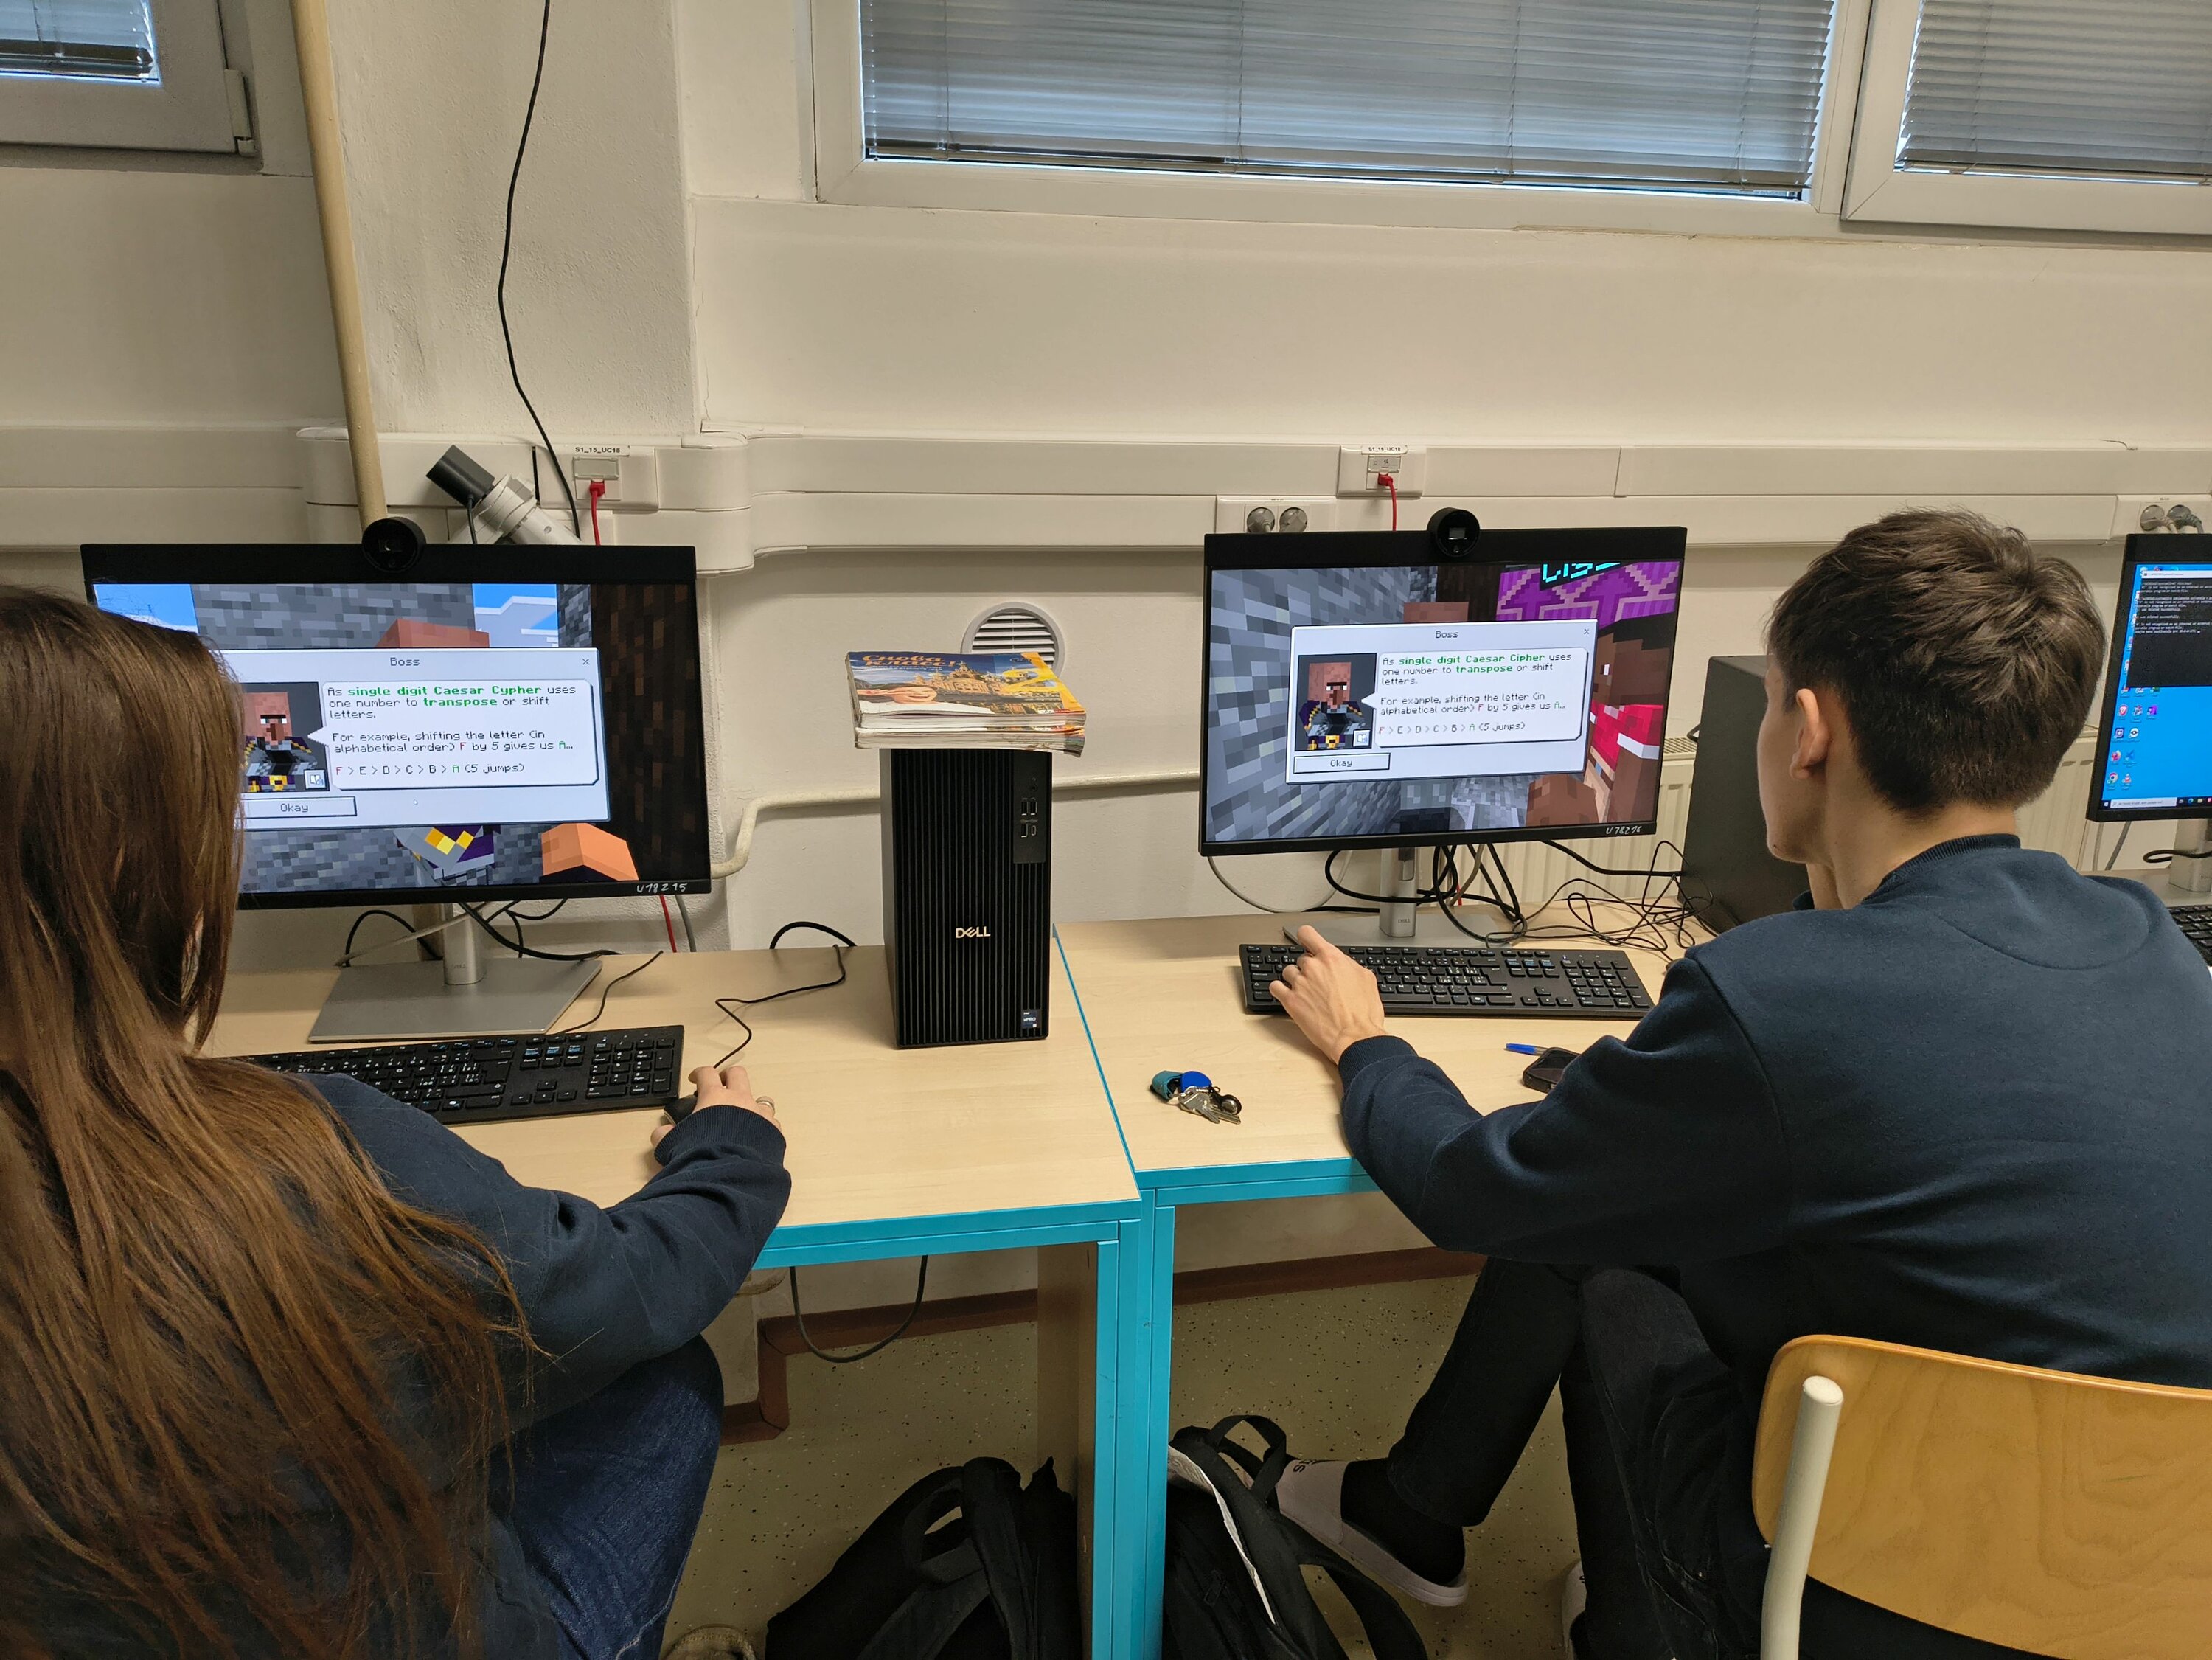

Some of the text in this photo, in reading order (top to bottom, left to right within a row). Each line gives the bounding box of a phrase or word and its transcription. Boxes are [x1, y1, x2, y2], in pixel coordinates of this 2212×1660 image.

[1436, 631, 1458, 639] Boss
[390, 657, 420, 666] Boss
[1399, 657, 1432, 665] single
[1437, 656, 1460, 664] digit
[1510, 654, 1545, 662] Cipher
[1531, 663, 1553, 671] shift
[327, 687, 342, 696] As
[348, 687, 391, 697] single
[397, 687, 427, 696] digit
[434, 687, 485, 695] Caesar
[492, 686, 542, 695] Cypher
[356, 698, 400, 707] number
[406, 698, 417, 706] to
[423, 698, 497, 706] transpose
[522, 696, 549, 705] shift
[1402, 696, 1441, 704] example,
[330, 710, 375, 719] letters.
[1381, 706, 1437, 715] alphabetical
[1441, 704, 1474, 712] order)
[1512, 703, 1535, 711] gives
[1492, 722, 1525, 731] jumps)
[333, 730, 545, 742] For example, shifting the letter (in
[335, 743, 407, 754] alphabetical
[413, 743, 455, 751] order)
[460, 742, 467, 750] F
[472, 742, 487, 751] by
[492, 742, 499, 750] 5
[504, 741, 535, 751] gives
[336, 767, 342, 775] F
[360, 766, 366, 775] E
[383, 765, 390, 774] D
[406, 765, 413, 774] C
[429, 765, 436, 774] B
[465, 764, 478, 773] (5
[483, 763, 524, 774] jumps)
[281, 803, 308, 813] Okay
[956, 926, 990, 938] DELL
